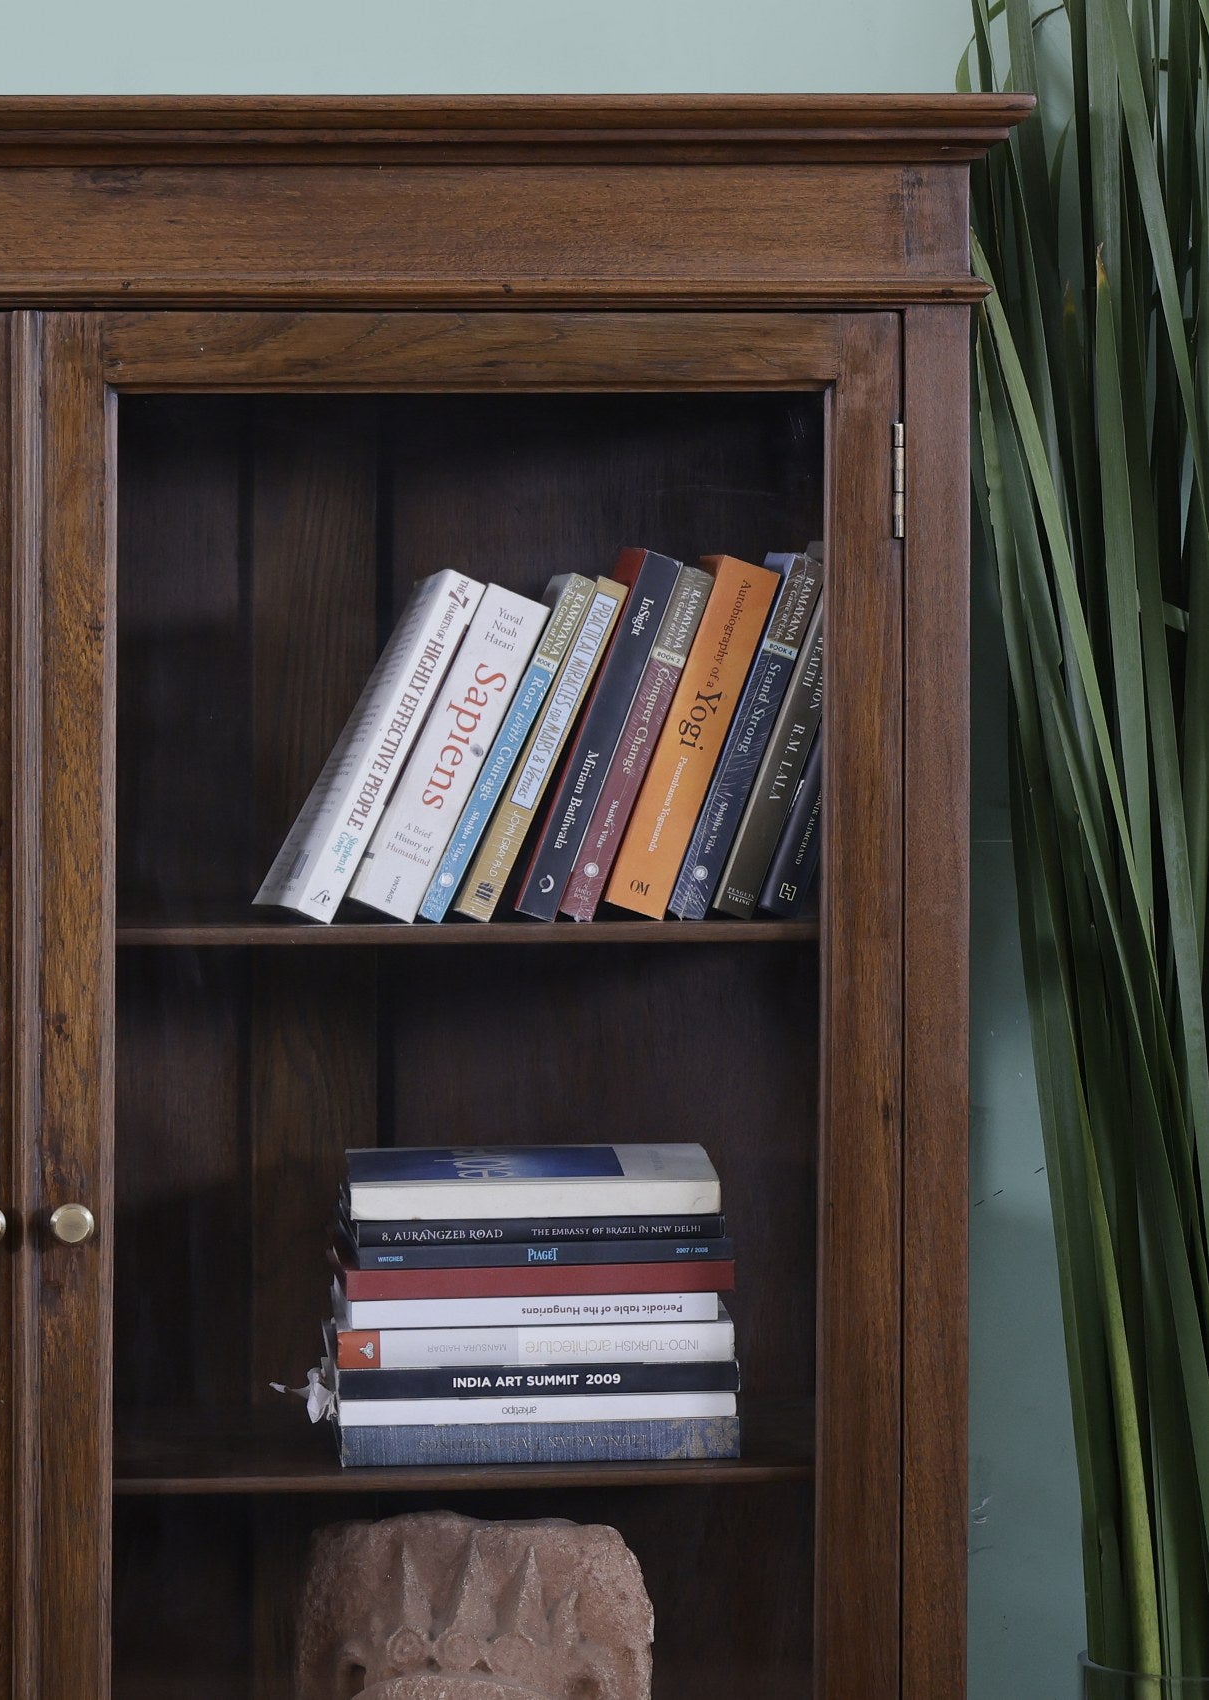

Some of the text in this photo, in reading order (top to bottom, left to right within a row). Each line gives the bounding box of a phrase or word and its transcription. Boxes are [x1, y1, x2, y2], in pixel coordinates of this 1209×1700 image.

[498, 608, 524, 626] Yuval
[631, 596, 655, 637] InSight
[663, 586, 691, 648] The Game of Life
[673, 588, 702, 650] RAMAYANA
[775, 574, 805, 639] The Game of Life
[785, 576, 816, 642] RAMAYANA
[492, 620, 517, 638] Noah
[543, 606, 568, 653] Game Life
[550, 592, 586, 656] RAMAYANA
[707, 579, 752, 688] Autobiography of a
[484, 632, 516, 652] Harari
[657, 651, 676, 662] BOOK
[769, 643, 787, 656] BOOK
[535, 657, 551, 668] BOOK
[347, 579, 470, 830] THE 7 HABITS OF HIGHLY EFFECTIVE PEOPLE
[517, 600, 611, 800] PRACTICAL MIRACLES FOR MARS & Venus
[737, 662, 781, 754] Stand Strong
[622, 666, 670, 774] Conquer Change
[678, 690, 723, 750] Yogi
[422, 662, 507, 810] Sapiens
[479, 675, 545, 801] Roar with Courage
[769, 760, 793, 800] LALA
[554, 750, 599, 850] Miriam Batliwala
[648, 756, 688, 852] Paramhansa Yogananda
[413, 825, 434, 839] Brief
[451, 810, 480, 862] Shubha Vilas
[507, 810, 525, 838] JOHN
[596, 798, 620, 848] Shubha Vilas
[704, 802, 729, 854] Shubha Vilas
[332, 832, 350, 856] Covey
[340, 836, 359, 866] Stephen
[386, 842, 431, 867] Humankind
[395, 832, 435, 854] History of
[795, 816, 815, 865] ALIMCHAND
[385, 875, 401, 904] VINTAGE
[629, 879, 651, 896] OM
[727, 886, 755, 899] PENGUIN
[728, 895, 750, 906] VIKING
[381, 1229, 503, 1242] 8, AURANGZEB ROAD
[531, 1224, 701, 1236] THE EMBASSY OF BRAZIL IN NEW DELHI
[527, 1248, 559, 1262] PIAGET
[695, 1246, 709, 1254] 2008
[521, 1304, 683, 1316] Periodic table of the Hungarians
[427, 1343, 507, 1352] MANSURA HAIDAR
[525, 1339, 699, 1354] INDO-TURKISH architecture
[452, 1373, 621, 1388] INDIA ART SUMMIT 2009
[501, 1404, 538, 1416] arketipo
